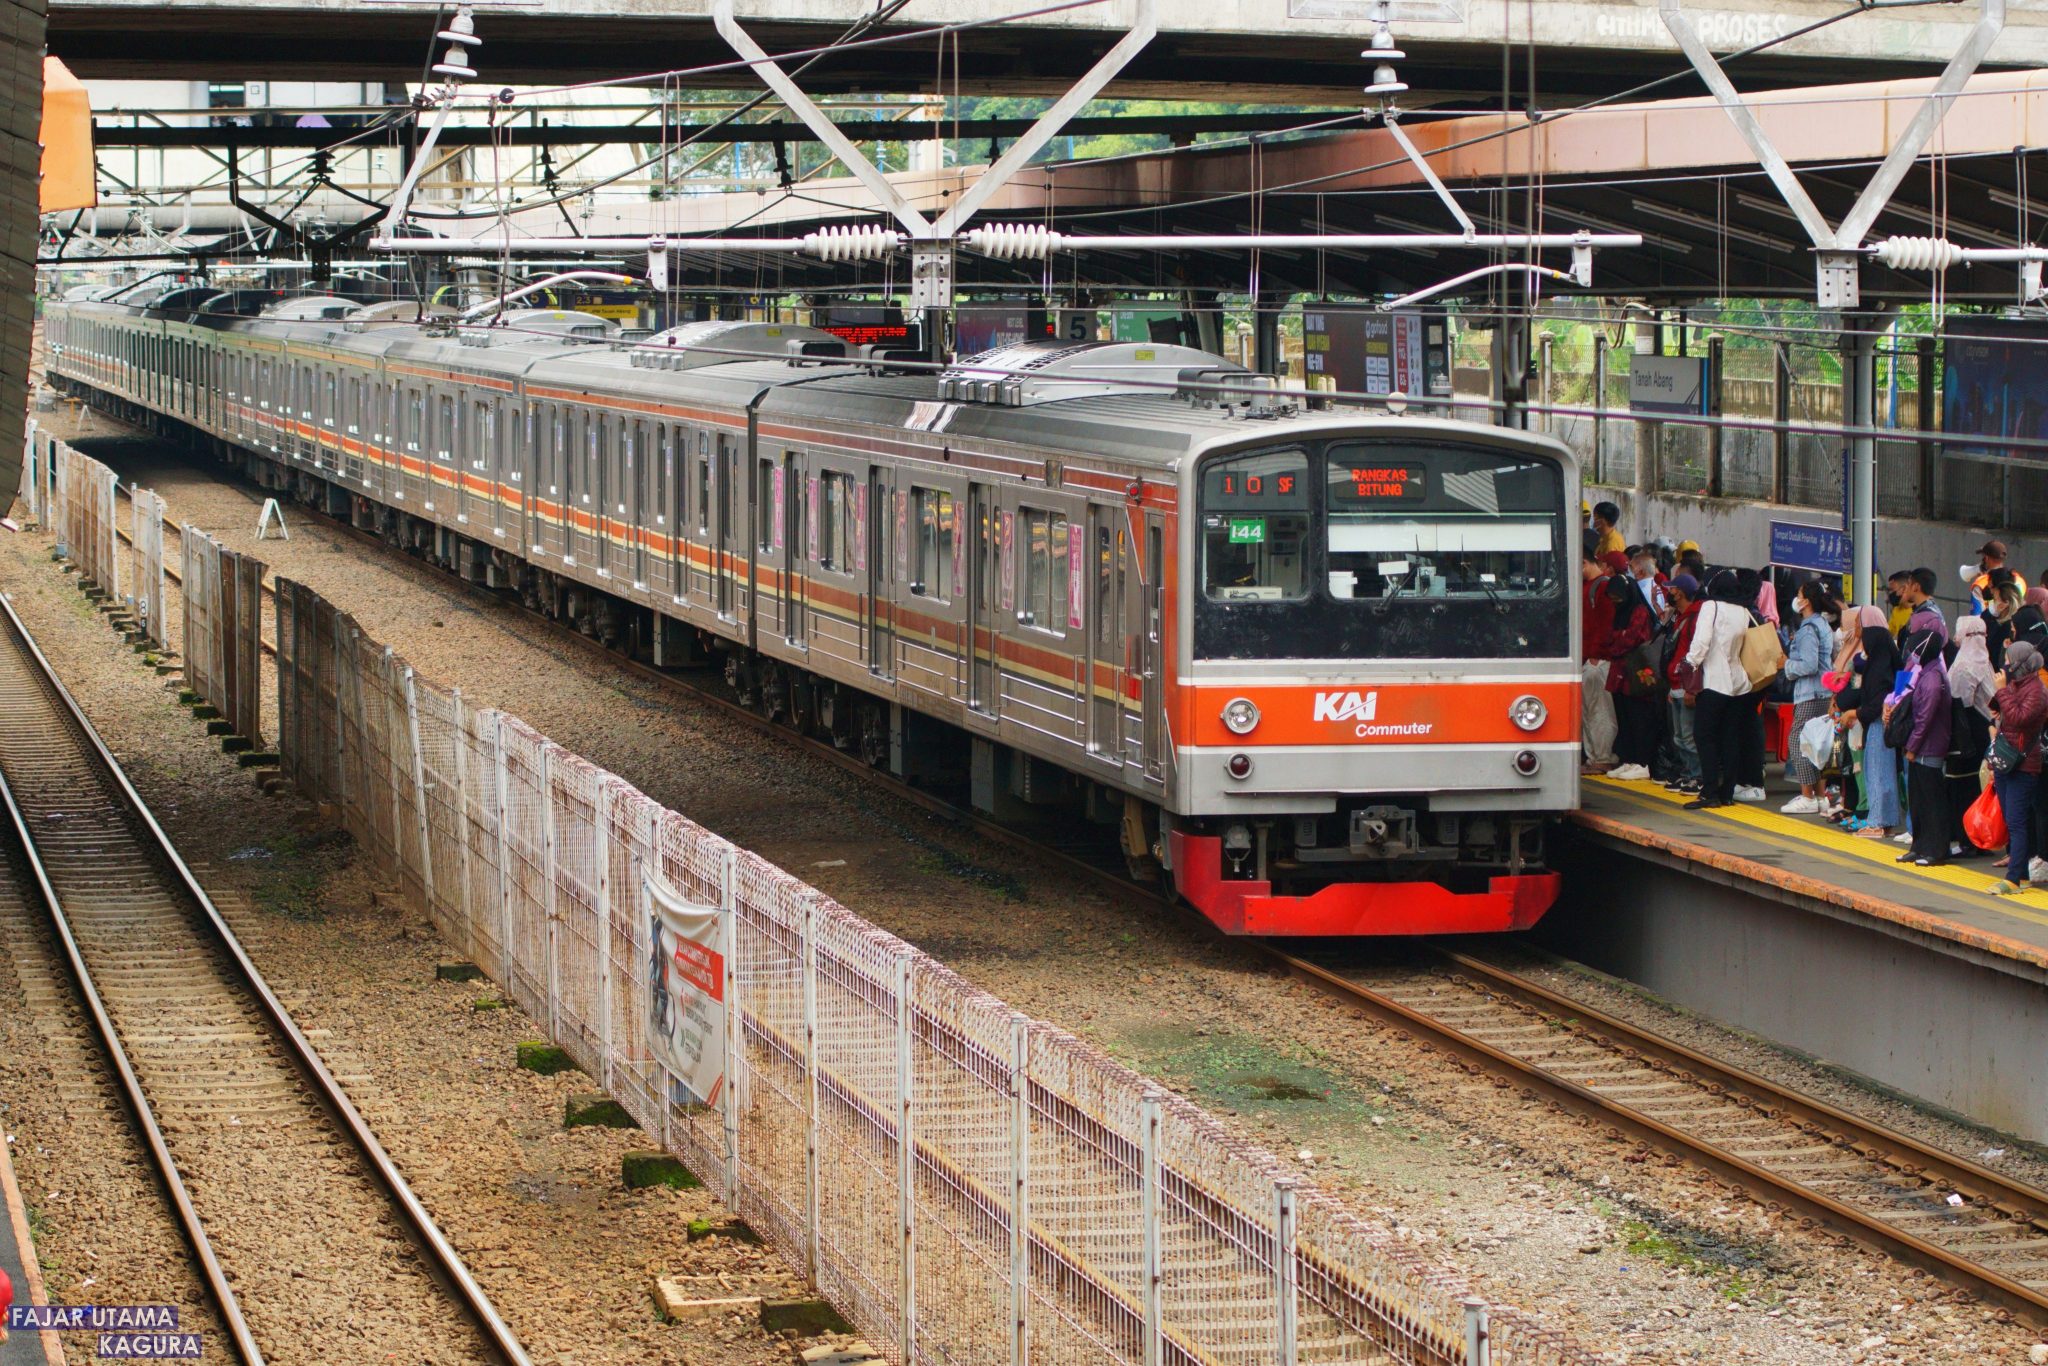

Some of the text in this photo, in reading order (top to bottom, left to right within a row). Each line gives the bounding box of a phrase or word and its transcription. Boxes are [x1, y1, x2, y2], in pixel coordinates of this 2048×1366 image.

[1699, 13, 1787, 44] PROSES
[1070, 316, 1087, 340] 5
[1635, 370, 1673, 392] Tanah Abang
[1352, 469, 1408, 481] RANGKAS
[1358, 483, 1402, 497] BITUNG
[1313, 691, 1377, 721] KAI
[1355, 722, 1432, 737] Commuter
